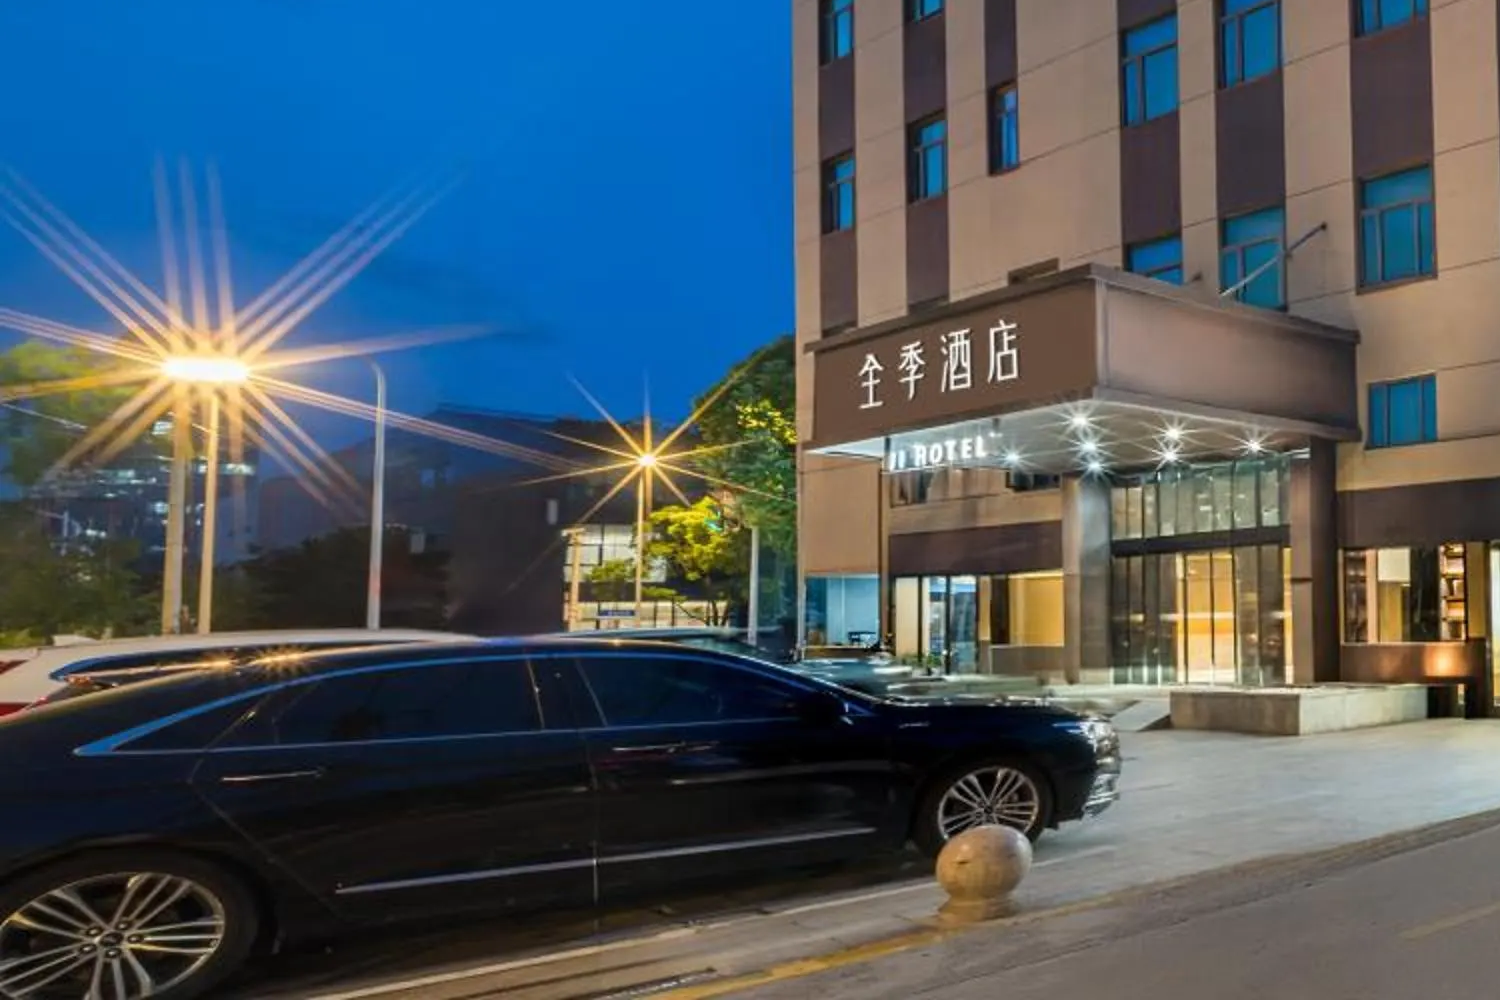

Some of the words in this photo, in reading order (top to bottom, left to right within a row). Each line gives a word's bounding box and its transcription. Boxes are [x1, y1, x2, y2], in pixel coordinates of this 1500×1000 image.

[858, 319, 1019, 409] 全季酒店
[914, 435, 987, 467] HOTEL
